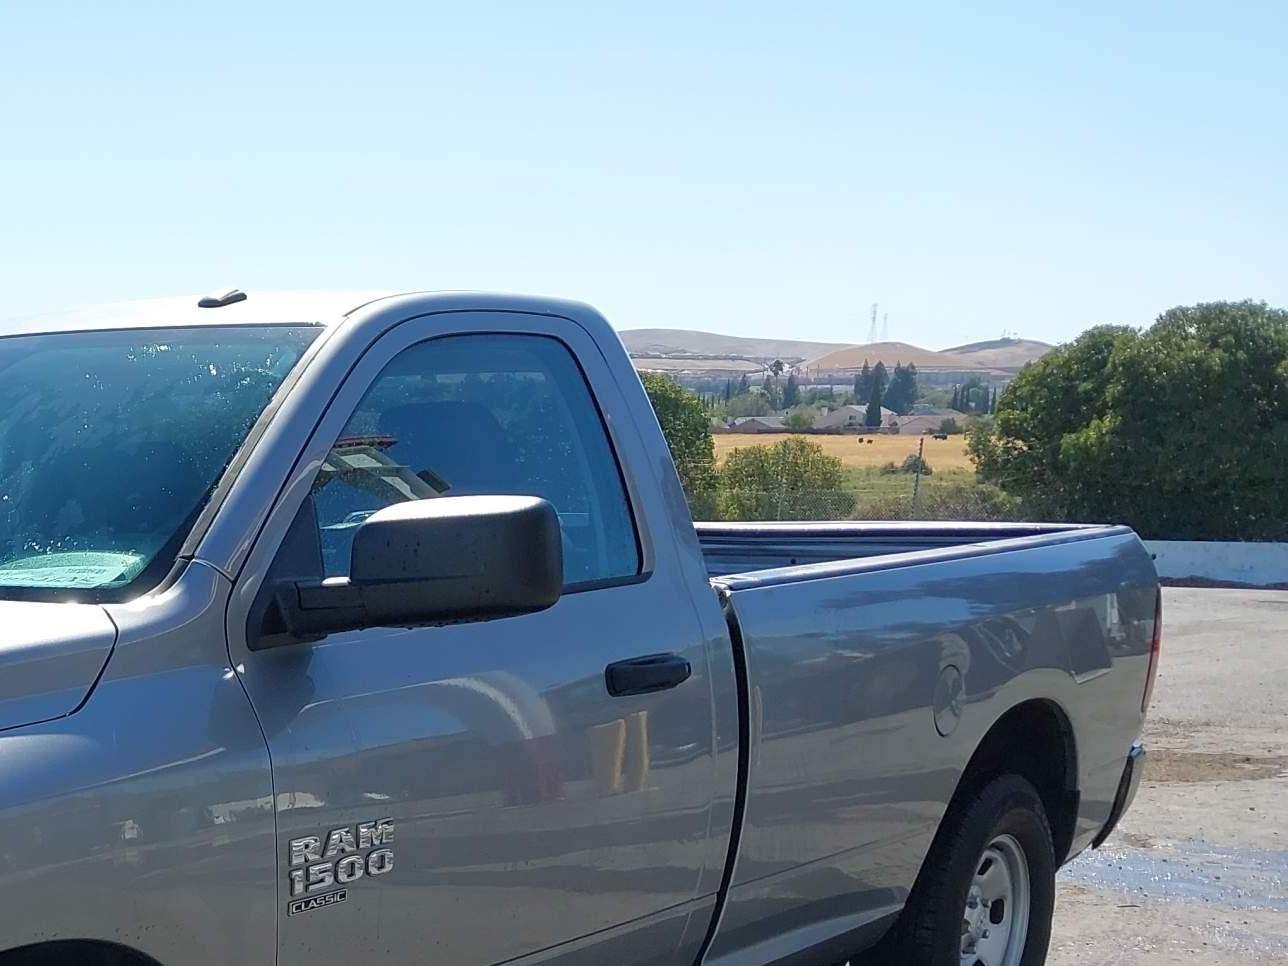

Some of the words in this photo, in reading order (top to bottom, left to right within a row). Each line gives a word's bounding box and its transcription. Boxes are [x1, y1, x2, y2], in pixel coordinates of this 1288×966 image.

[289, 817, 395, 867] RAM
[289, 848, 395, 897] 1500
[291, 891, 346, 914] CLASSIC
